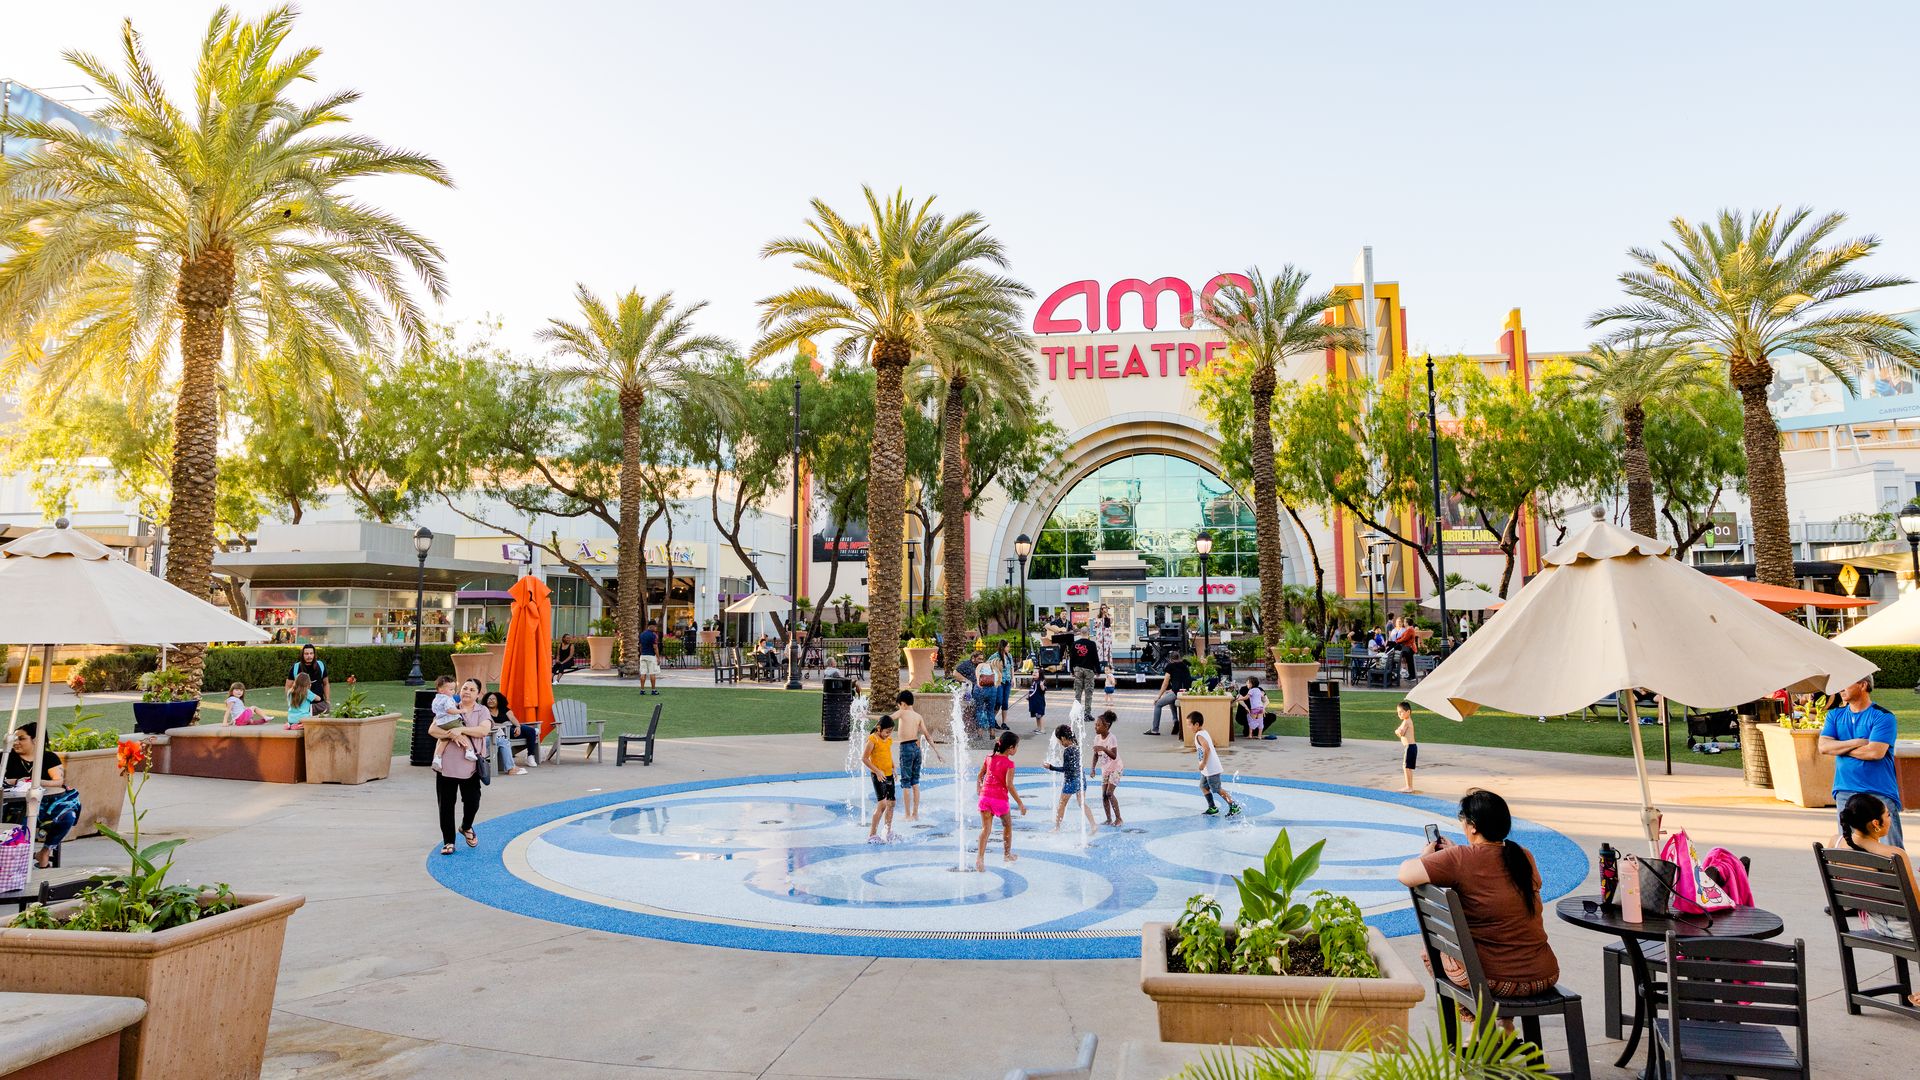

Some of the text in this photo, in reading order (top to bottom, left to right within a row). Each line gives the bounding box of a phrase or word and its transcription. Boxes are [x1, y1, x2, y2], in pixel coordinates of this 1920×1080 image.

[1041, 341, 1248, 380] THEATRE
[571, 539, 609, 562] As
[1146, 584, 1189, 595] COME
